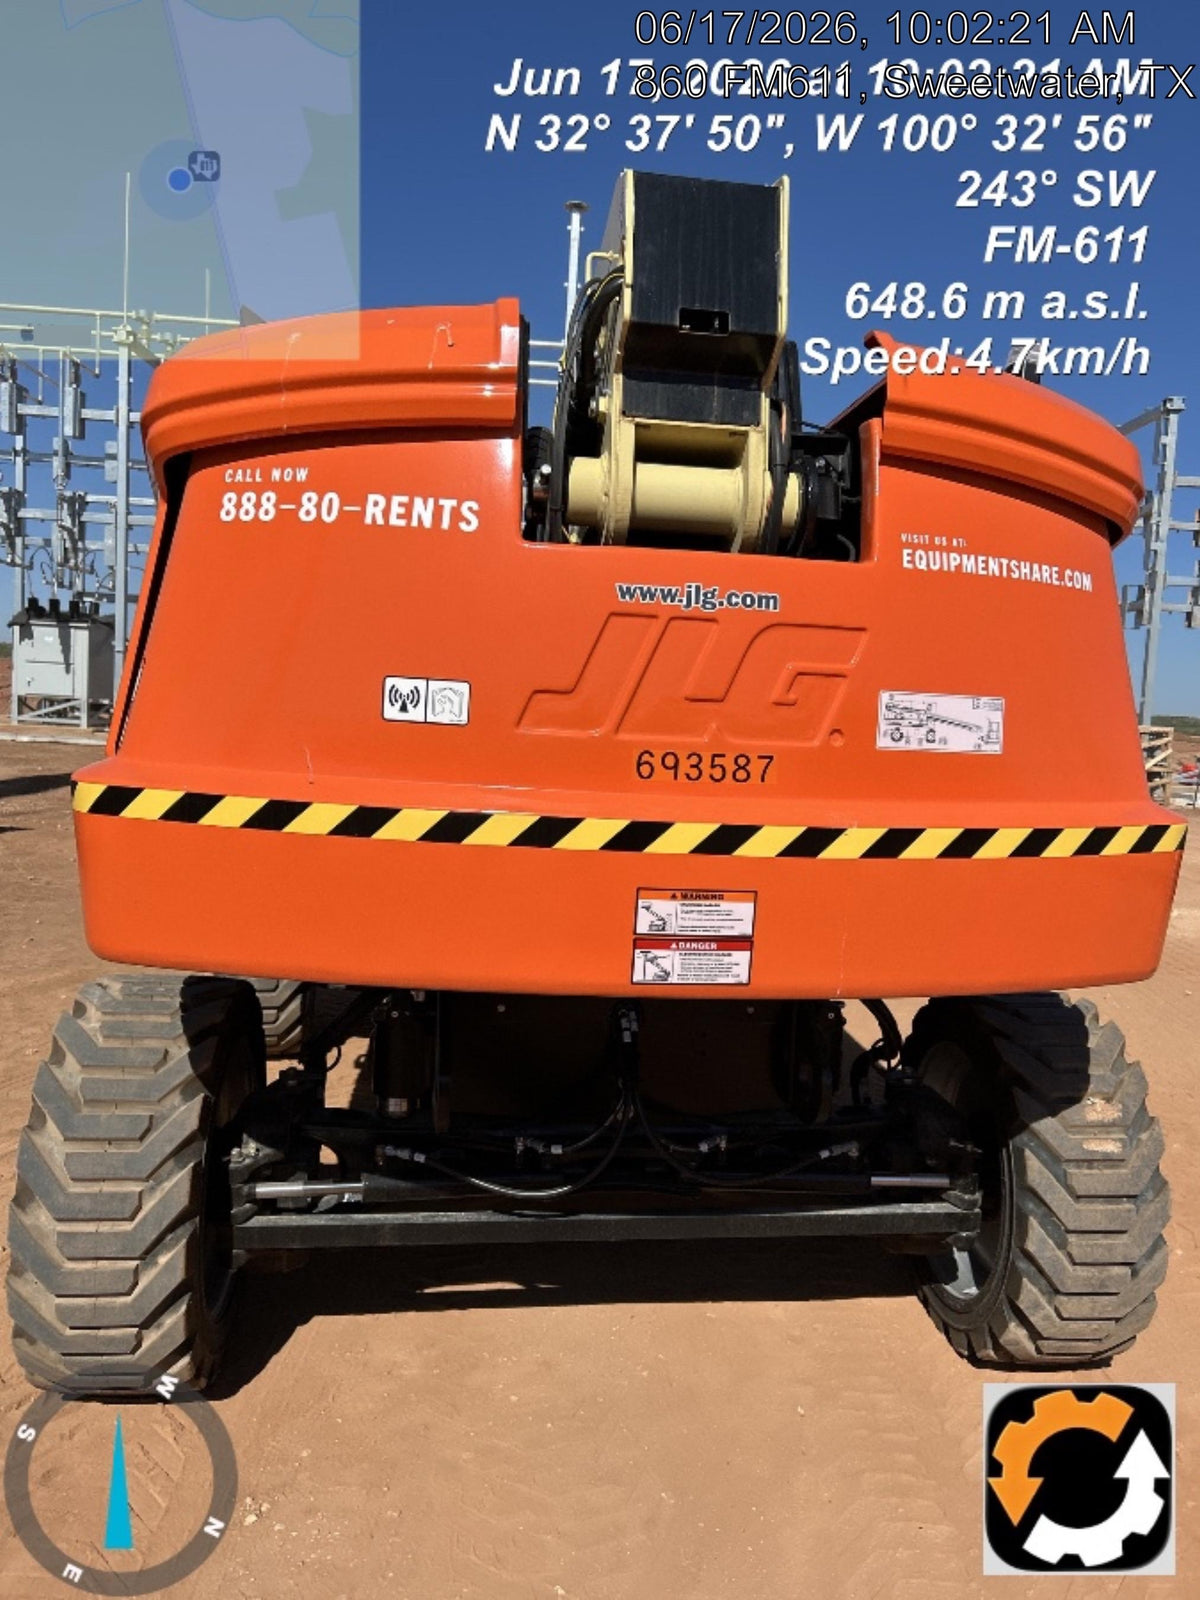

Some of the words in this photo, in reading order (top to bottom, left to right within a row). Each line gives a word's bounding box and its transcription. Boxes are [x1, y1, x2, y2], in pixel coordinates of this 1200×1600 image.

[224, 469, 263, 483] CALL
[271, 467, 309, 482] NOW
[219, 490, 481, 532] 888-80-RENTS
[901, 533, 930, 545] VISIT
[934, 536, 948, 546] US
[902, 548, 1093, 592] EQUIPMENTSHARE.COM
[616, 582, 781, 612] www.jlg.com
[636, 750, 775, 783] 693587
[678, 941, 718, 950] DANGER
